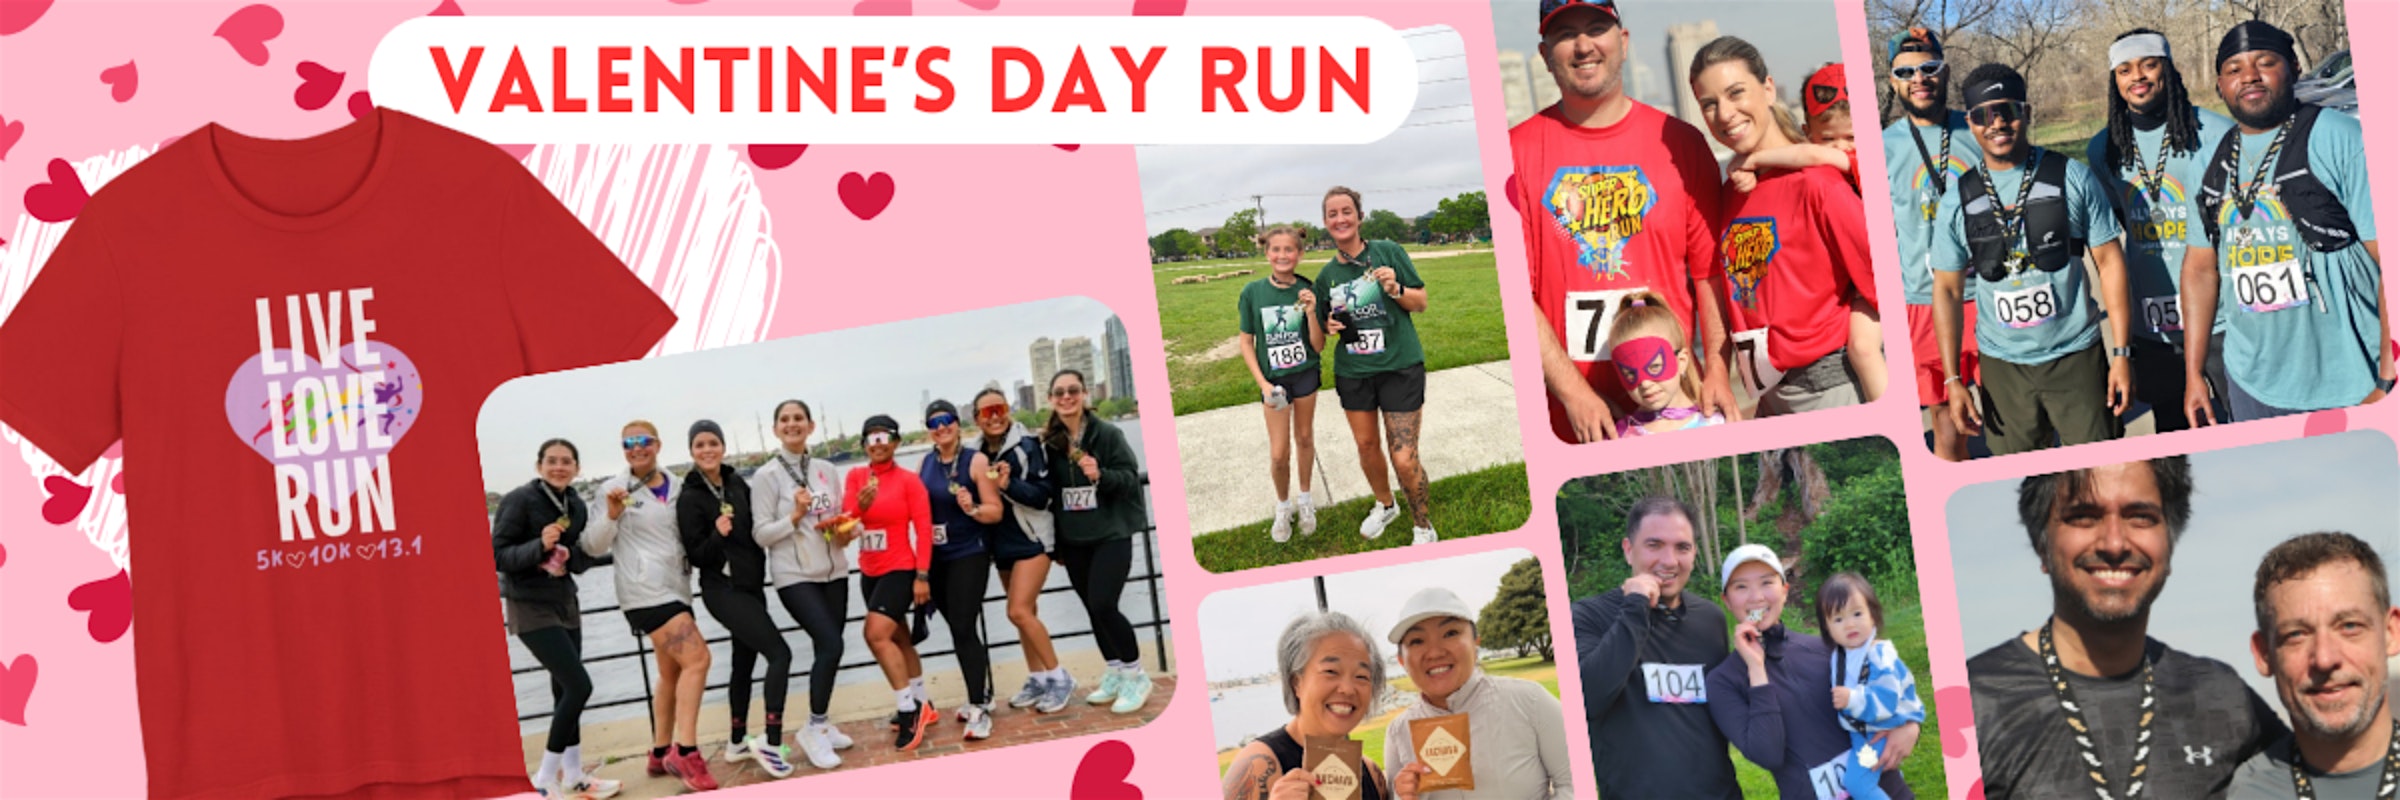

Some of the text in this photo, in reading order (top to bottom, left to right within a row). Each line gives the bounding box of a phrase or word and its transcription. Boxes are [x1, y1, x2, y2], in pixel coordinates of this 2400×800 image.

[1583, 184, 1648, 229] HERO
[1610, 214, 1642, 241] RUN
[2132, 221, 2187, 240] HOPE
[2237, 267, 2298, 305] 061
[1997, 290, 2053, 323] 058
[255, 287, 382, 375] LIVE
[1352, 333, 1381, 351] 87
[1576, 300, 1604, 354] 7
[1271, 345, 1305, 366] 186
[267, 370, 393, 458] LOVE
[274, 454, 396, 542] RUN
[808, 493, 831, 512] 26
[1063, 489, 1093, 507] 027
[257, 535, 422, 570] 5K 10K 13.1
[1651, 668, 1703, 698] 104
